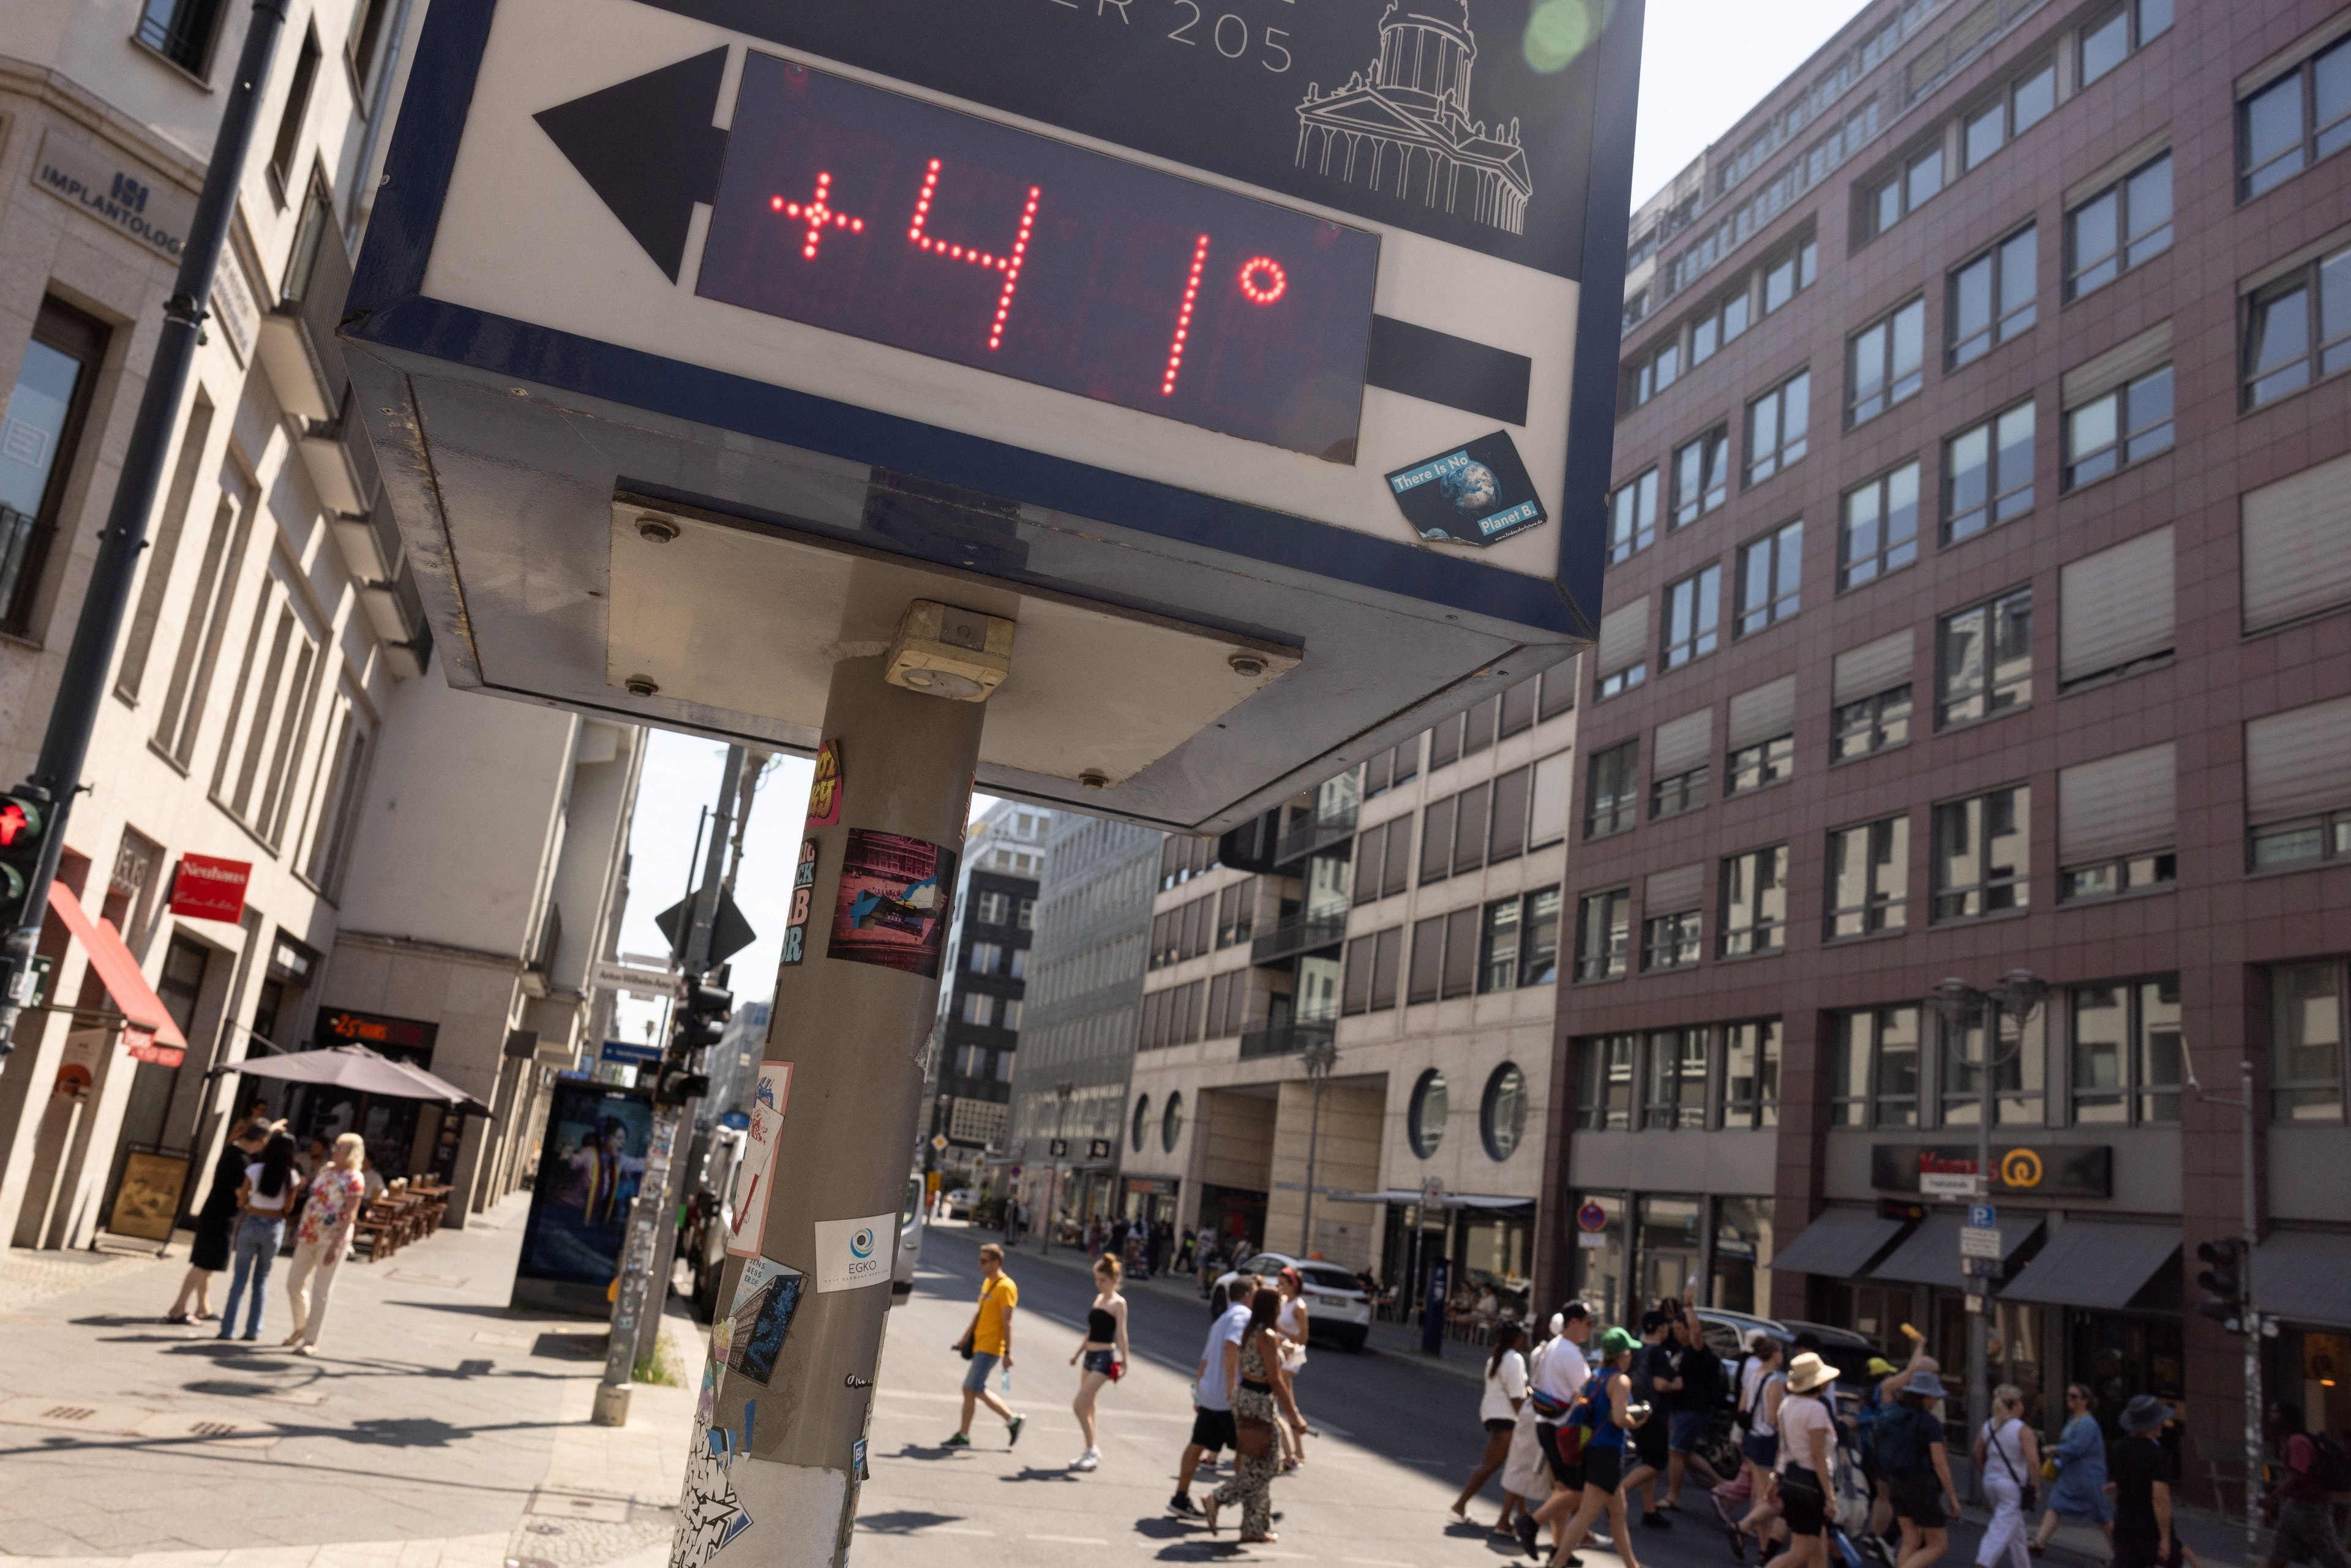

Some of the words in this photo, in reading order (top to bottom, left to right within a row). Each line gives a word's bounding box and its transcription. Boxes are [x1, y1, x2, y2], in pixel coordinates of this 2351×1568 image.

[1168, 0, 1291, 72] 205
[41, 164, 182, 255] IMPLANTOLOG
[1394, 470, 1433, 489] There
[1435, 463, 1447, 475] Is
[1447, 455, 1468, 470] No
[1480, 510, 1520, 533] Planet
[1521, 505, 1537, 517] B.
[1494, 519, 1543, 542] www.fridaysforfuture.de
[181, 861, 246, 885] Neuhaus
[795, 862, 814, 885] CK
[787, 889, 809, 926] B
[747, 1266, 762, 1278] BESS
[750, 1258, 765, 1269] JENS
[849, 1260, 877, 1274] EGKO
[744, 1275, 759, 1287] ER.DE
